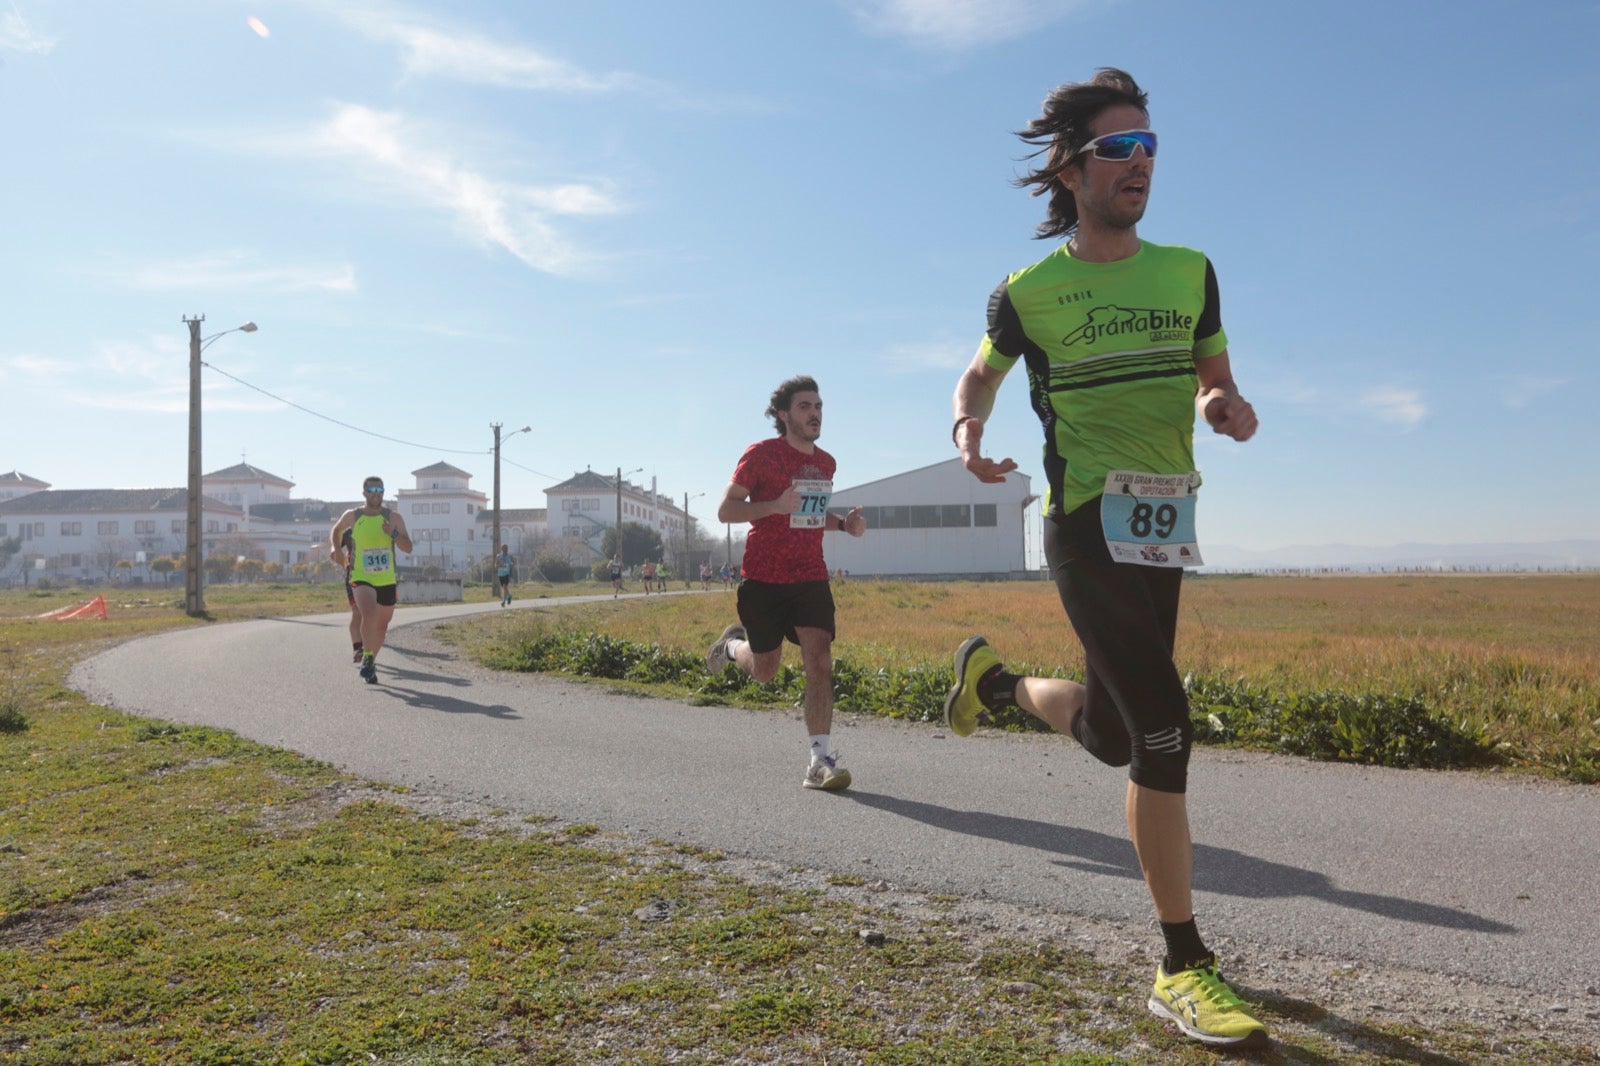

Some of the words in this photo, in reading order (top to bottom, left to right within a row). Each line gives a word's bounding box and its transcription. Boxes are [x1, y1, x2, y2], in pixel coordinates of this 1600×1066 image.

[1134, 475, 1153, 485] GRAN
[1152, 476, 1176, 486] PREMIO
[801, 495, 827, 513] 779
[1131, 503, 1177, 538] 89
[367, 555, 387, 565] 316
